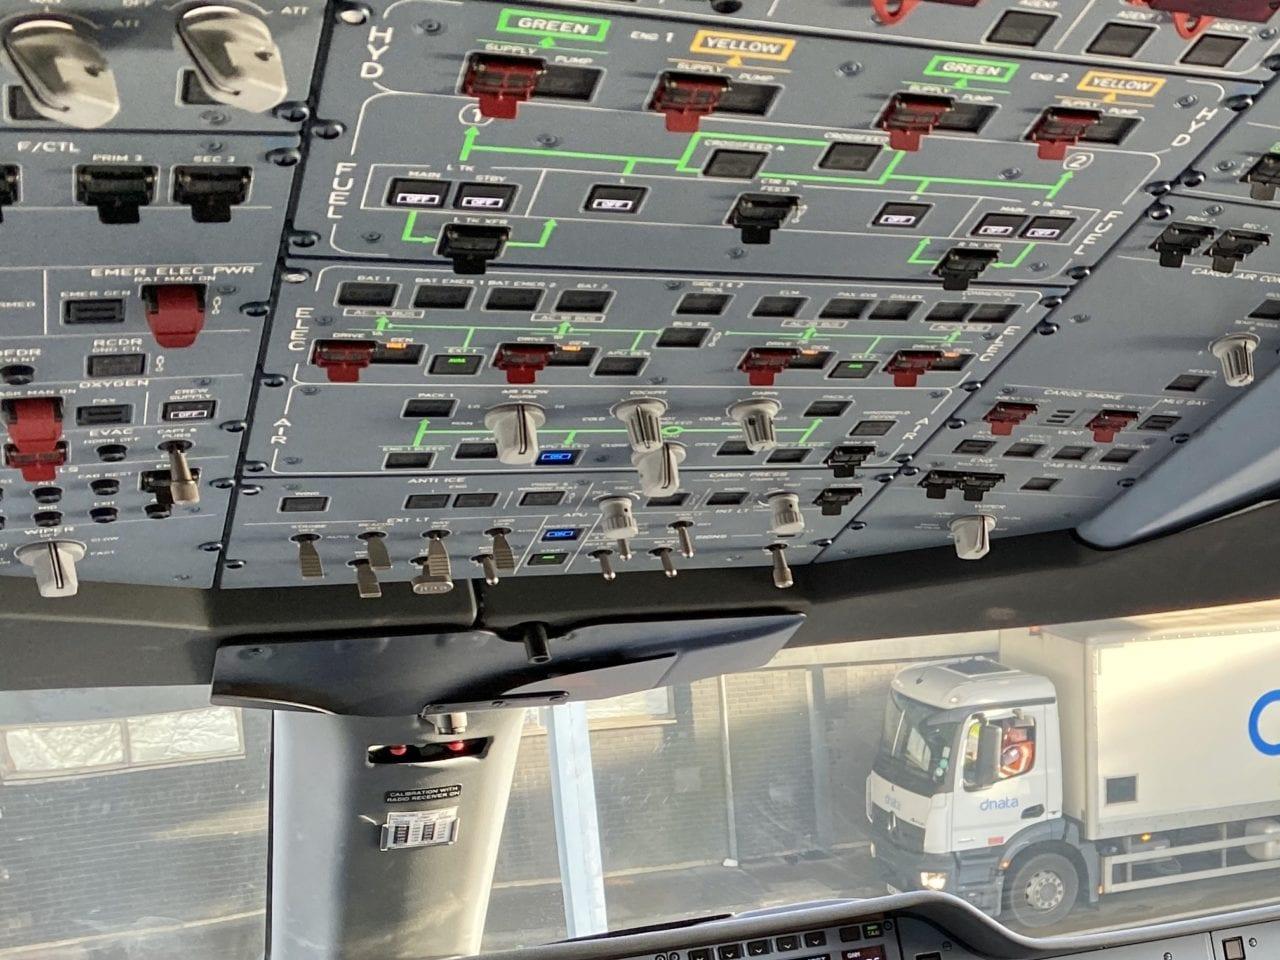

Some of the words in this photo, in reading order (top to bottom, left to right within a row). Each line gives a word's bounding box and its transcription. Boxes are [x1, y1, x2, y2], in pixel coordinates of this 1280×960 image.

[518, 18, 590, 34] GREEN
[485, 43, 538, 54] SUPPLY
[706, 36, 780, 54] YELLOW
[361, 26, 394, 78] HYD
[942, 62, 1000, 76] GREEN
[1092, 76, 1151, 90] YELLOW
[18, 142, 80, 152] F/CTL
[327, 163, 357, 219] FUEL
[91, 268, 146, 276] EMER
[156, 267, 204, 276] ELEC
[213, 266, 254, 274] PWR
[93, 338, 142, 346] RCDR
[79, 379, 149, 389] OXYGEN
[89, 428, 135, 436] EVAC
[390, 789, 438, 798] CALIBRATION
[980, 798, 1019, 812] dnata
